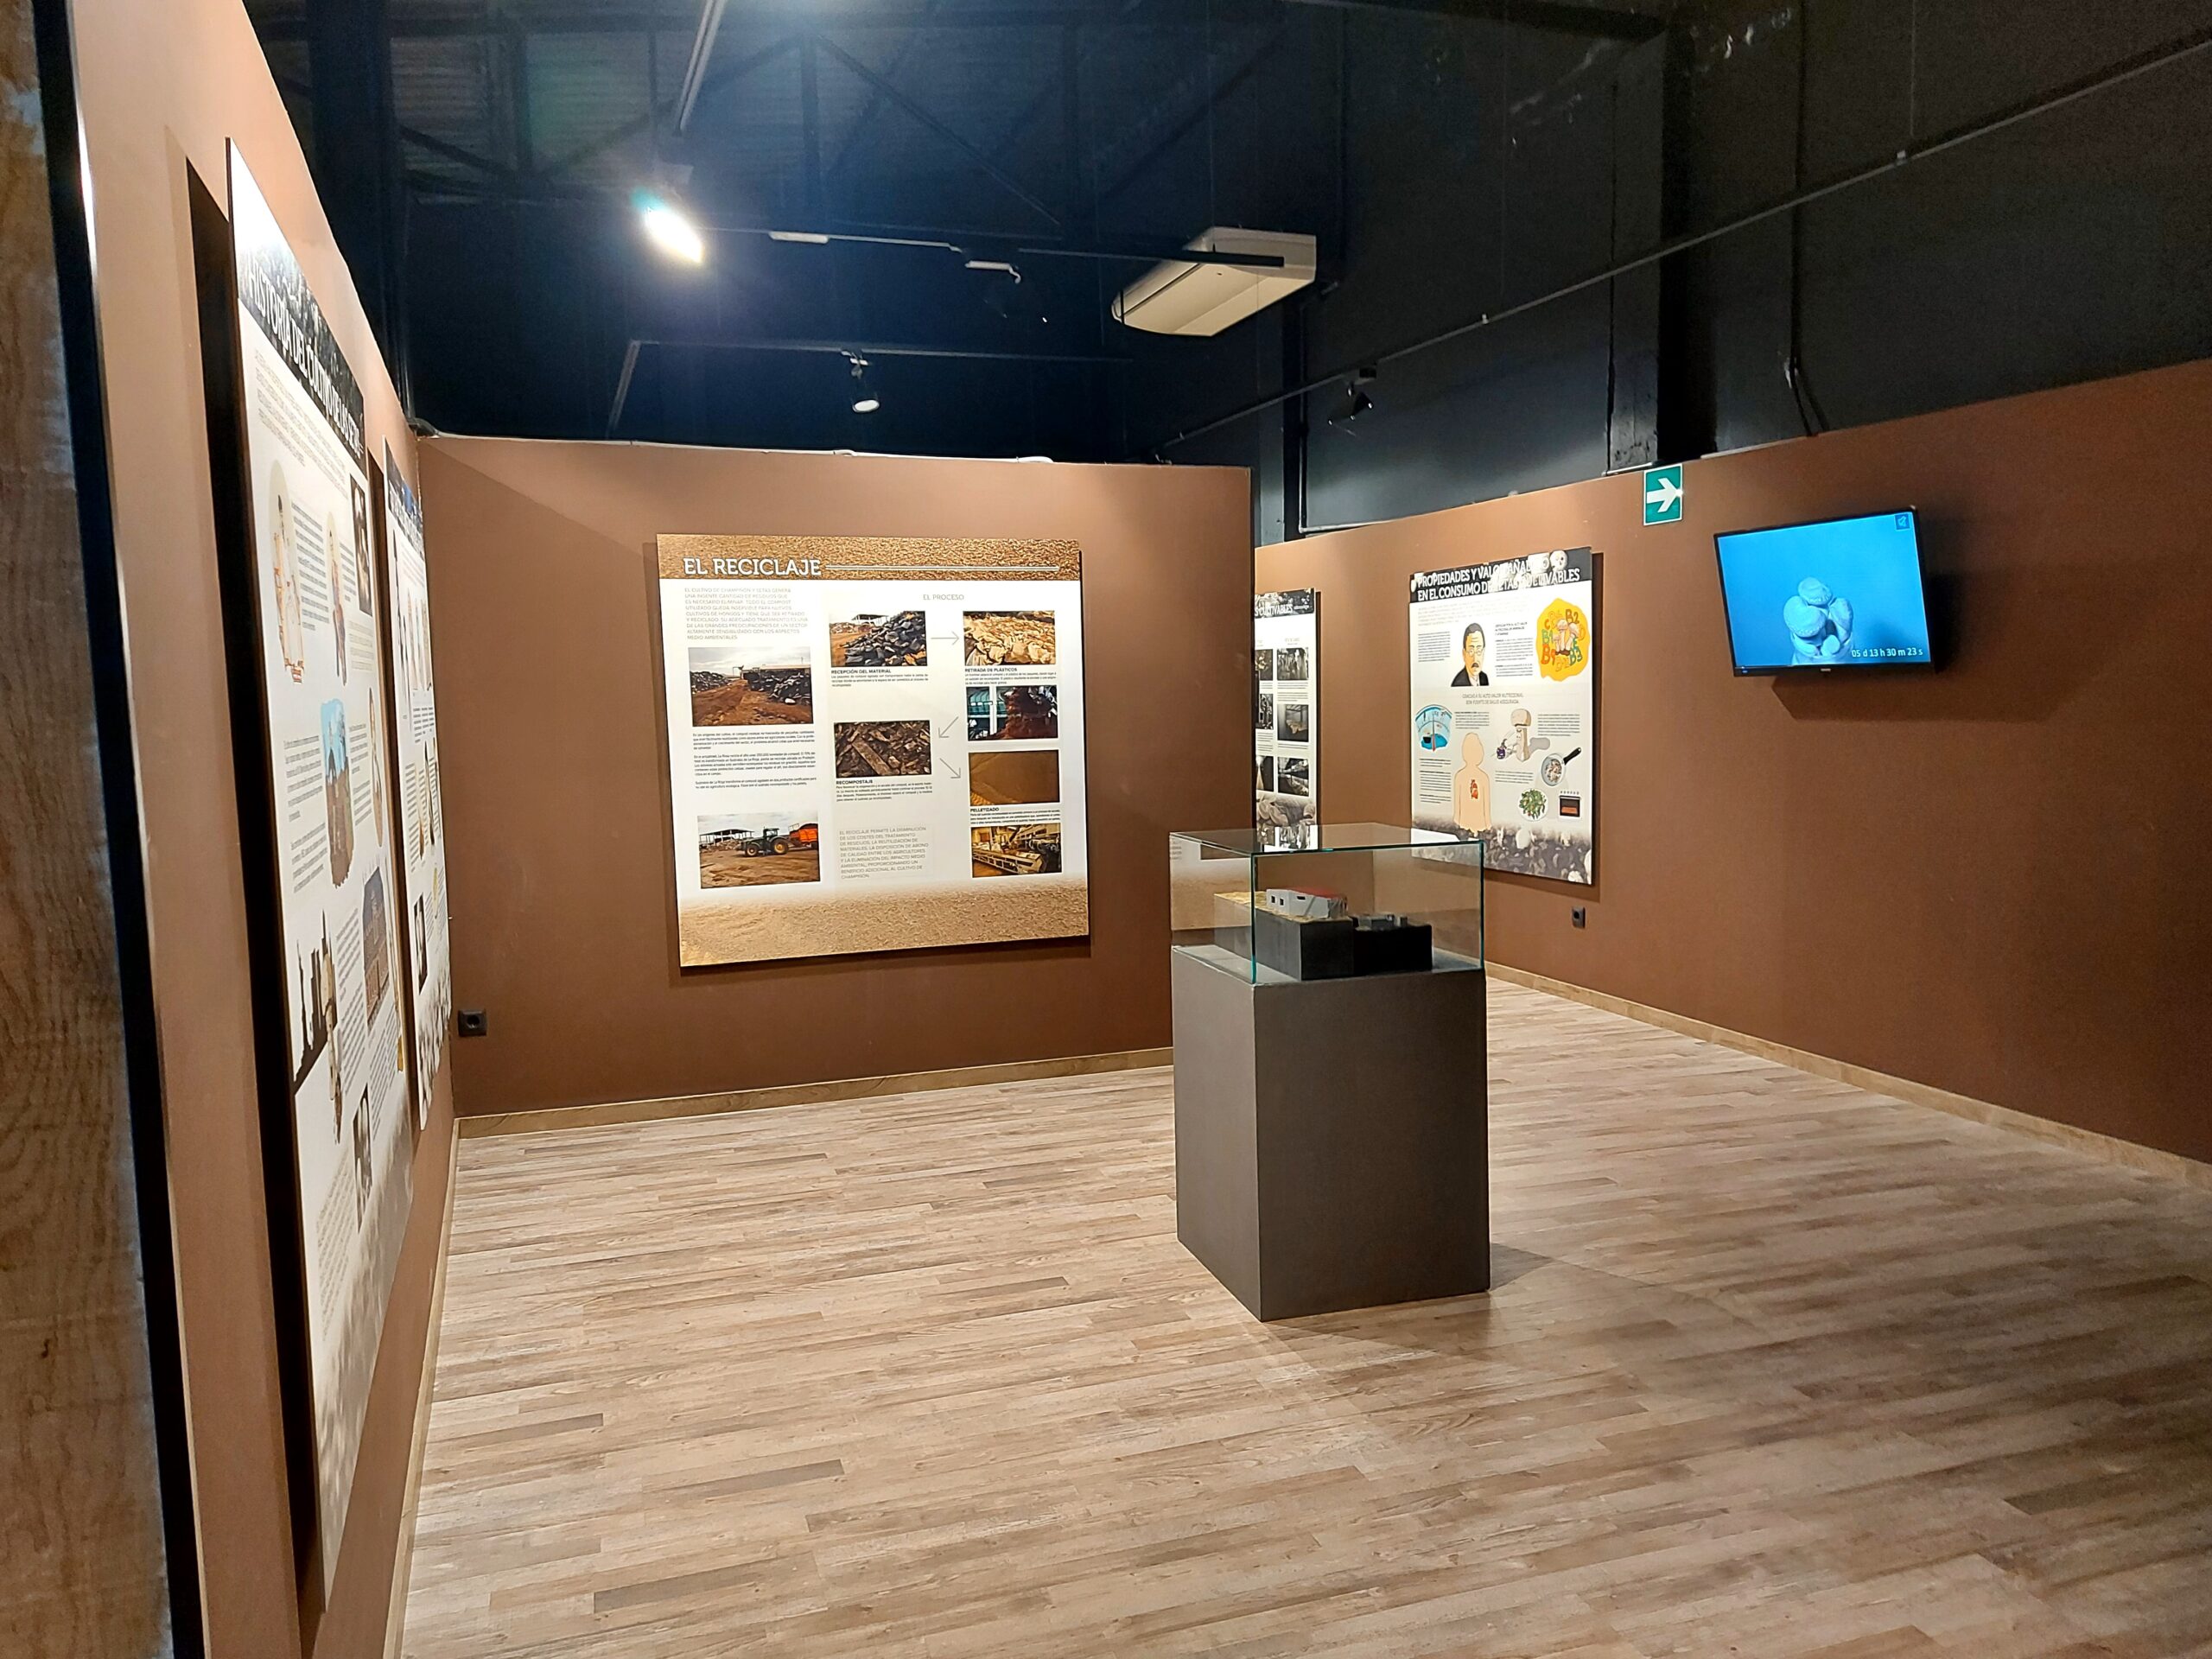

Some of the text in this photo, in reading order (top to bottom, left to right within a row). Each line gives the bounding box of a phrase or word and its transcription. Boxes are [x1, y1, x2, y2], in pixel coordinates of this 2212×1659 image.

[249, 255, 292, 357] HISTORIA
[292, 317, 308, 379] DEL
[683, 558, 821, 575] EL RECICLAJE
[1417, 569, 1470, 588] PROPIEDADES
[1471, 568, 1477, 581] Y
[1417, 588, 1428, 601] EN
[1429, 588, 1439, 600] EL
[1439, 582, 1480, 599] CONSUMO
[1544, 619, 1550, 630] C
[1566, 609, 1580, 624] B2
[1870, 648, 1878, 657] 13
[1879, 648, 1885, 657] h
